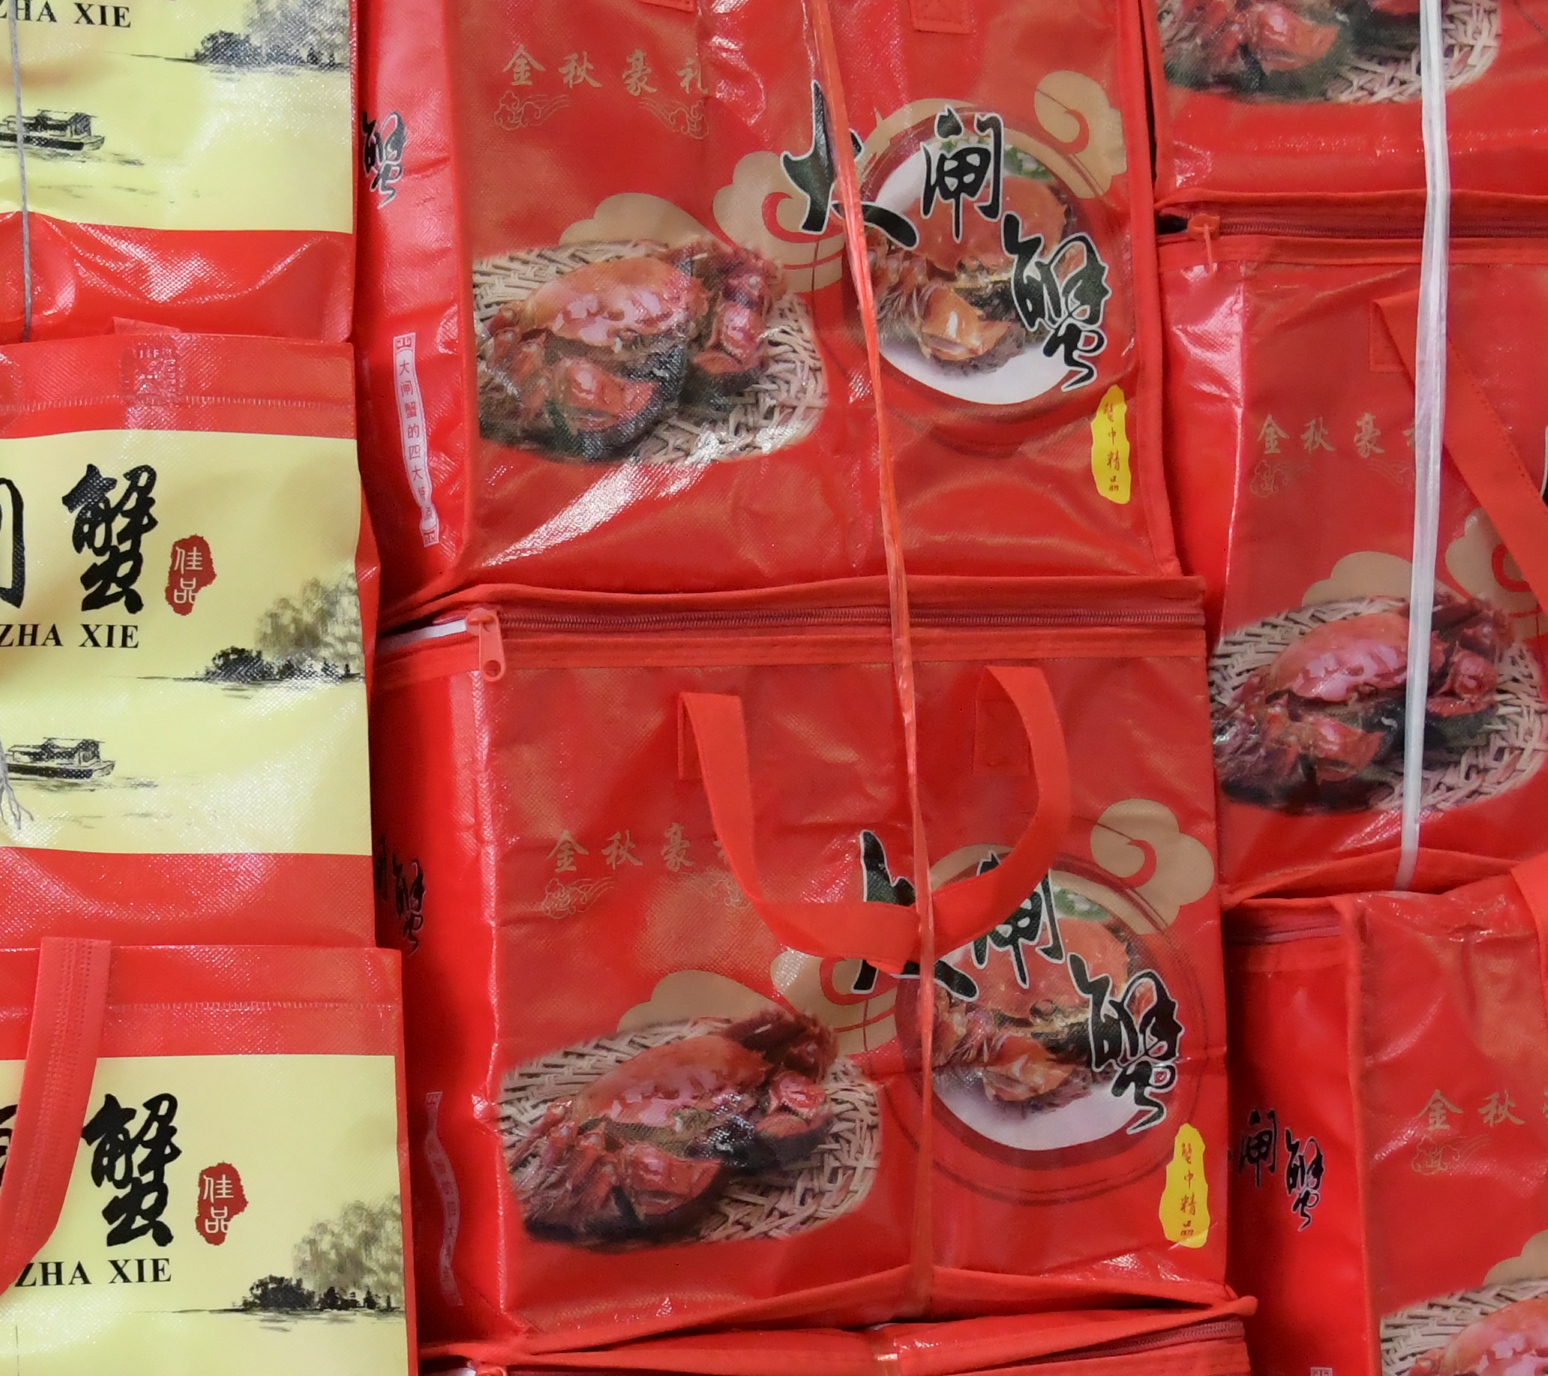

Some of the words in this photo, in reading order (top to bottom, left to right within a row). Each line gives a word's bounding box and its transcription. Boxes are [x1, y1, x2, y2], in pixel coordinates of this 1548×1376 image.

[73, 1, 133, 29] XIE
[503, 47, 710, 94] 金秋豪礼
[781, 83, 1109, 390] 大闸蟹
[172, 546, 206, 605] 佳品
[79, 623, 140, 649] XIE
[202, 1174, 235, 1234] 佳品
[15, 1261, 92, 1288] ZHA
[108, 1257, 172, 1285] XIE
